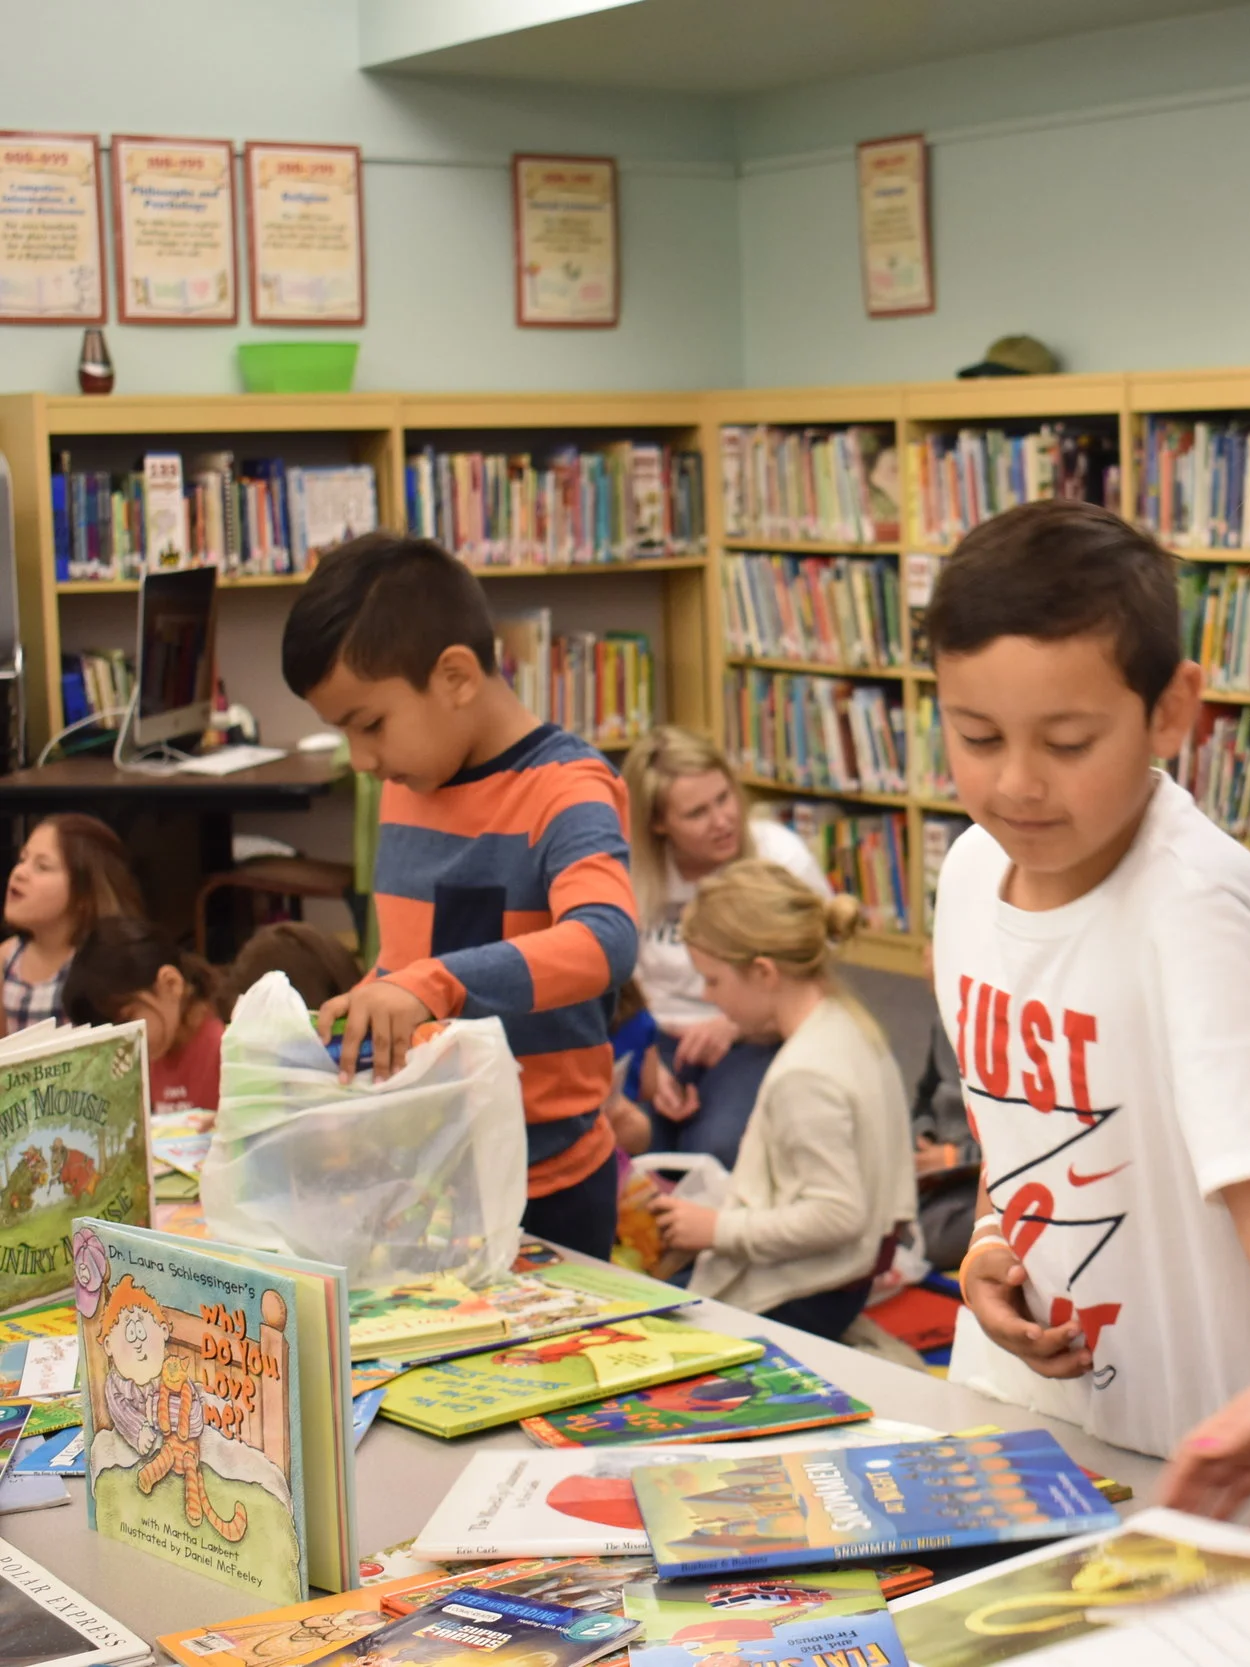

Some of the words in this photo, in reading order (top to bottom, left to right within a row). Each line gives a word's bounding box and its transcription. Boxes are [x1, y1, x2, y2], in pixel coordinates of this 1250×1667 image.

[32, 1083, 112, 1127] MOUSE
[108, 1244, 126, 1262] Dr.
[128, 1250, 165, 1273] Laura
[168, 1262, 256, 1300] Schlessinger's
[801, 1460, 873, 1532] SNOWMEN
[140, 1517, 160, 1532] with
[163, 1523, 198, 1546] Martha
[200, 1538, 240, 1561] Lambert
[456, 1546, 473, 1555] Eric
[604, 1541, 620, 1551] The
[833, 1539, 898, 1560] SNOWMEN
[917, 1535, 952, 1551] NIGHT
[119, 1521, 167, 1549] Illustrated
[170, 1541, 181, 1556] by
[184, 1546, 213, 1567] Daniel
[216, 1559, 263, 1588] McFeeley
[0, 1555, 51, 1594] POLAR
[46, 1595, 127, 1648] EXPRESS
[454, 1592, 489, 1606] STEP
[503, 1601, 561, 1622] READING
[517, 1618, 542, 1628] reading
[542, 1622, 556, 1631] with
[579, 1622, 612, 1636] 2
[786, 1629, 859, 1646] Firehouse
[799, 1643, 823, 1654] the
[827, 1639, 853, 1649] and
